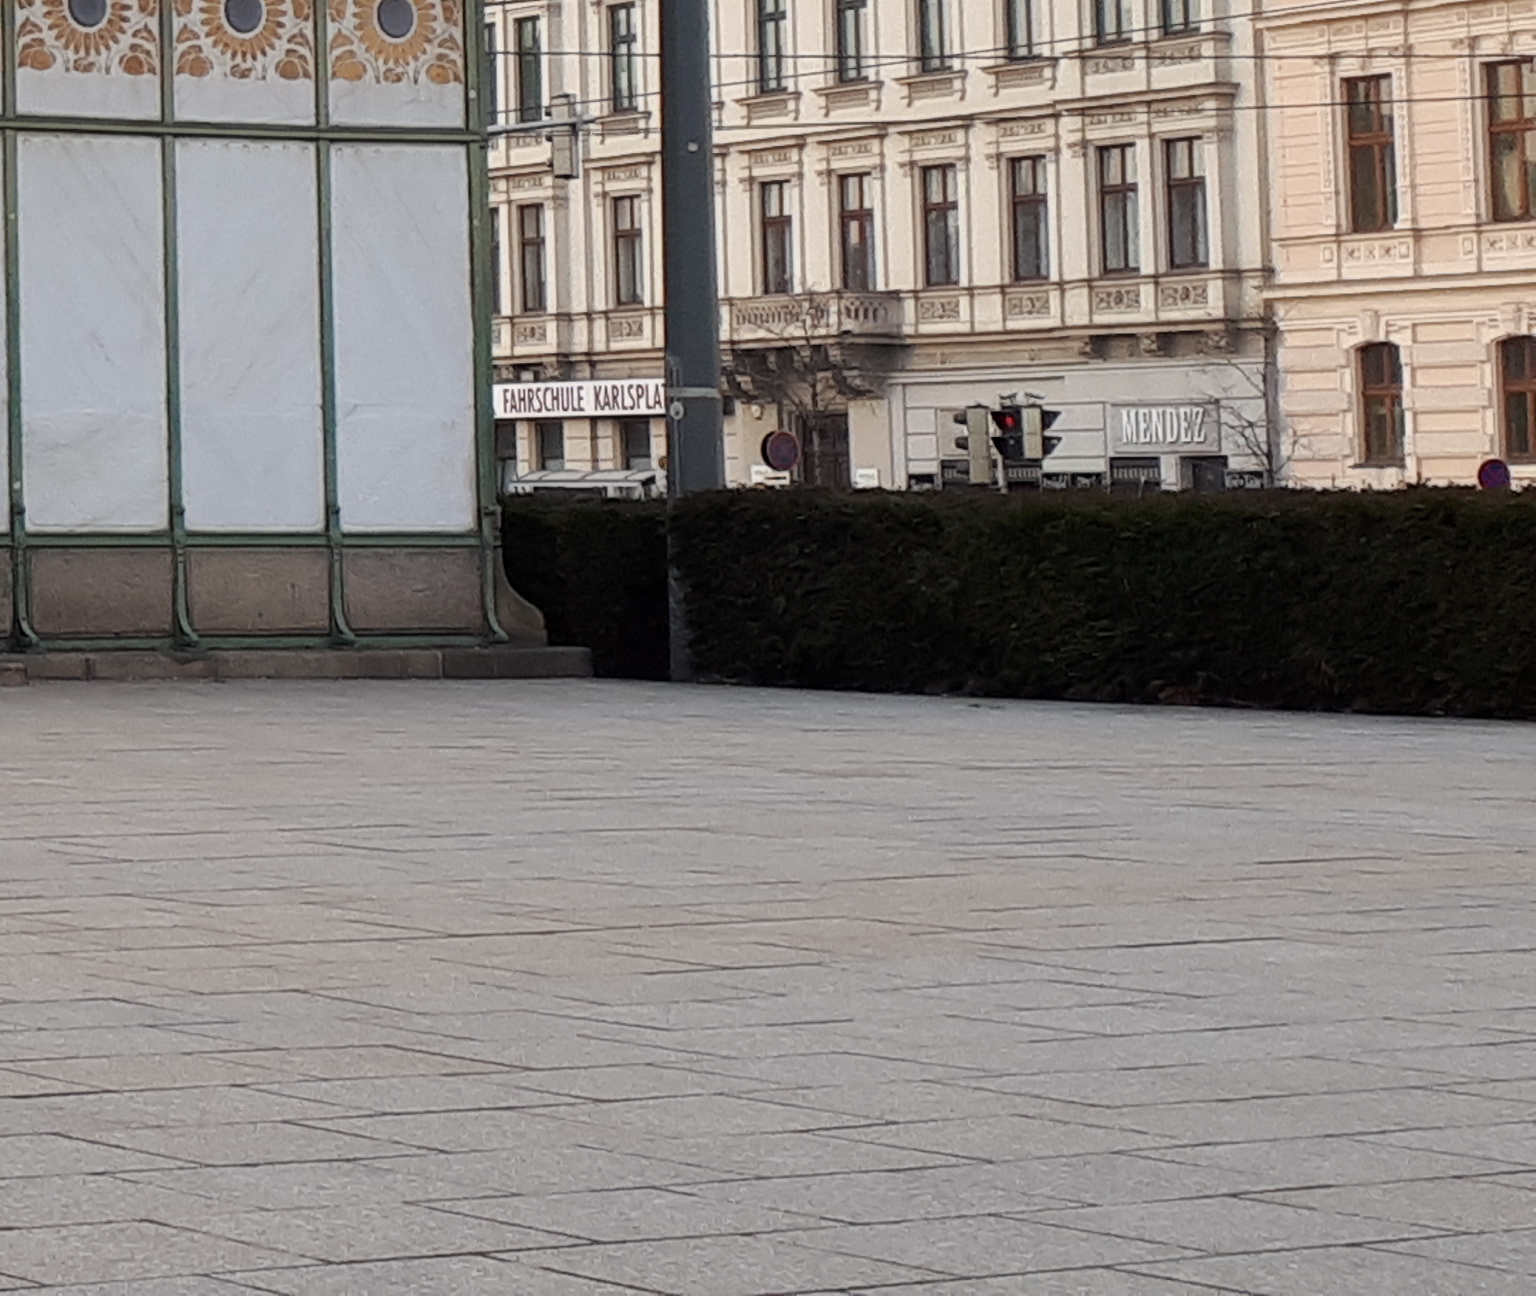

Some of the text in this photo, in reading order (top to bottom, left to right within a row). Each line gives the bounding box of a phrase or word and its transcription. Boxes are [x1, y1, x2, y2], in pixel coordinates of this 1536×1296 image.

[502, 383, 666, 414] FAHRSCHULE KARLSPLA
[1120, 406, 1206, 445] MENDEZ
